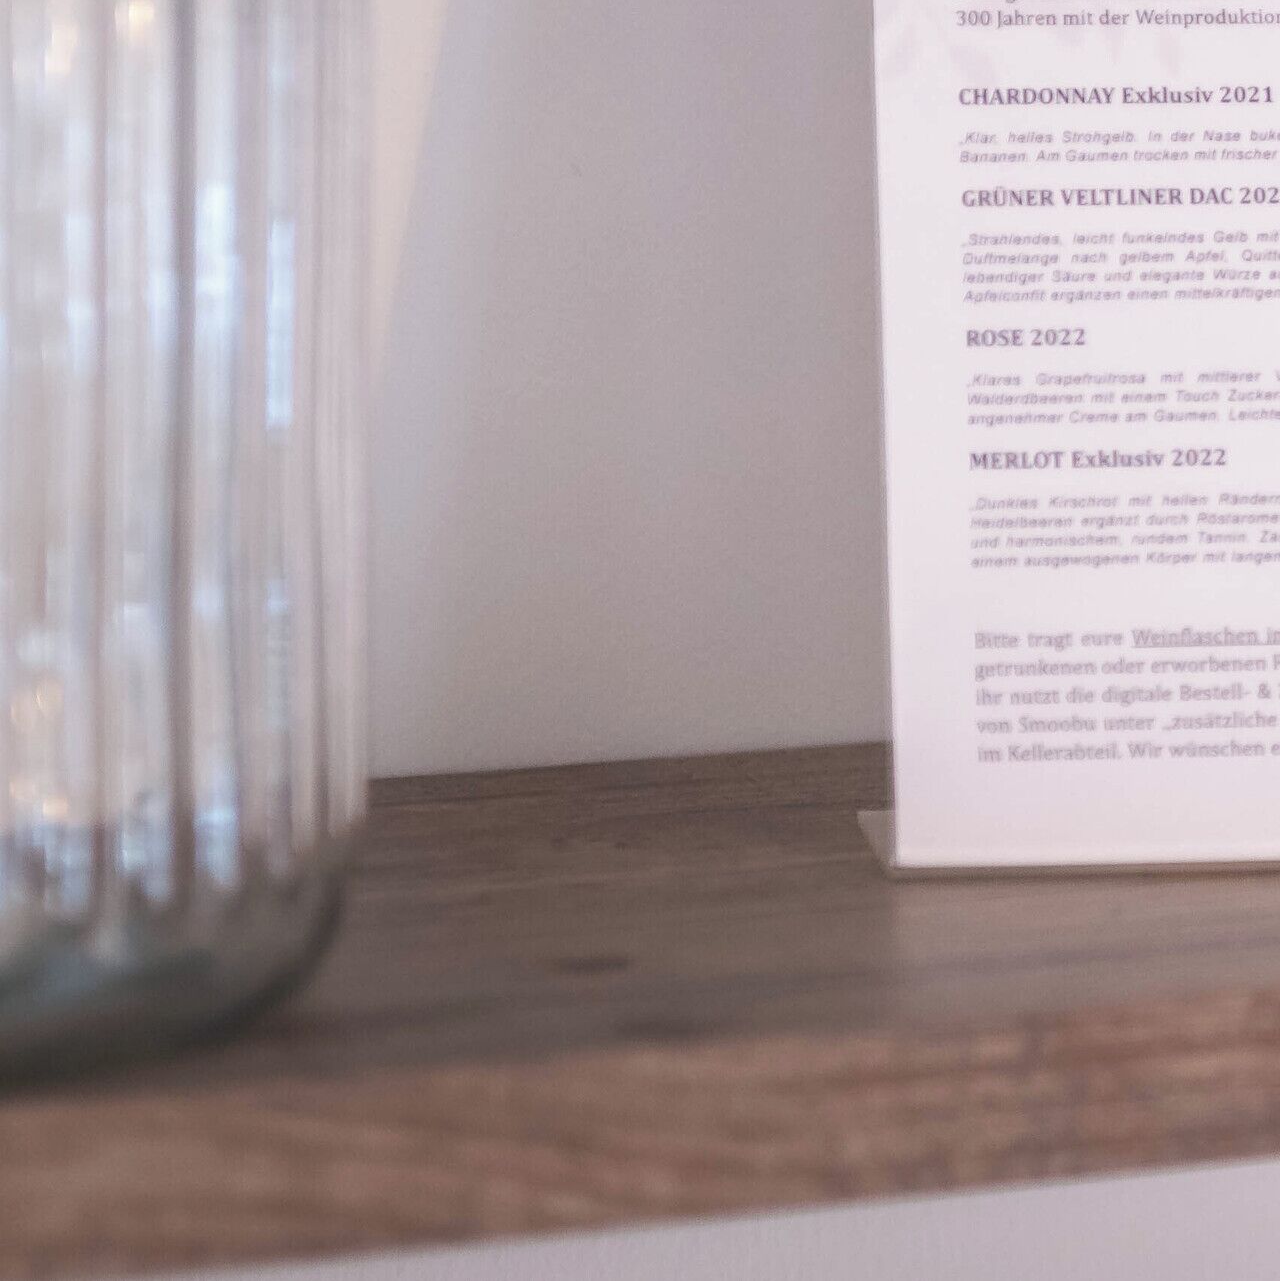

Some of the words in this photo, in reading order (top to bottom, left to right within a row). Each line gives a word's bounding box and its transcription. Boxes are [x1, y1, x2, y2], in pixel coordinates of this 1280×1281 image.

[956, 10, 992, 26] 300
[996, 10, 1057, 27] Jahren
[1062, 12, 1093, 26] mit
[1098, 9, 1129, 26] der
[958, 87, 1114, 105] CHARDONNAY
[1121, 86, 1213, 104] Exklusiv
[1219, 86, 1273, 103] 2021
[961, 186, 1054, 207] GRÜNER
[1061, 187, 1183, 206] VELTLINER
[1189, 187, 1232, 205] DAC
[965, 328, 1023, 347] ROSE
[1030, 328, 1086, 346] 2022
[968, 450, 1063, 470] MERLOT
[1071, 449, 1164, 468] Exklusiv
[1172, 448, 1227, 467] 2022
